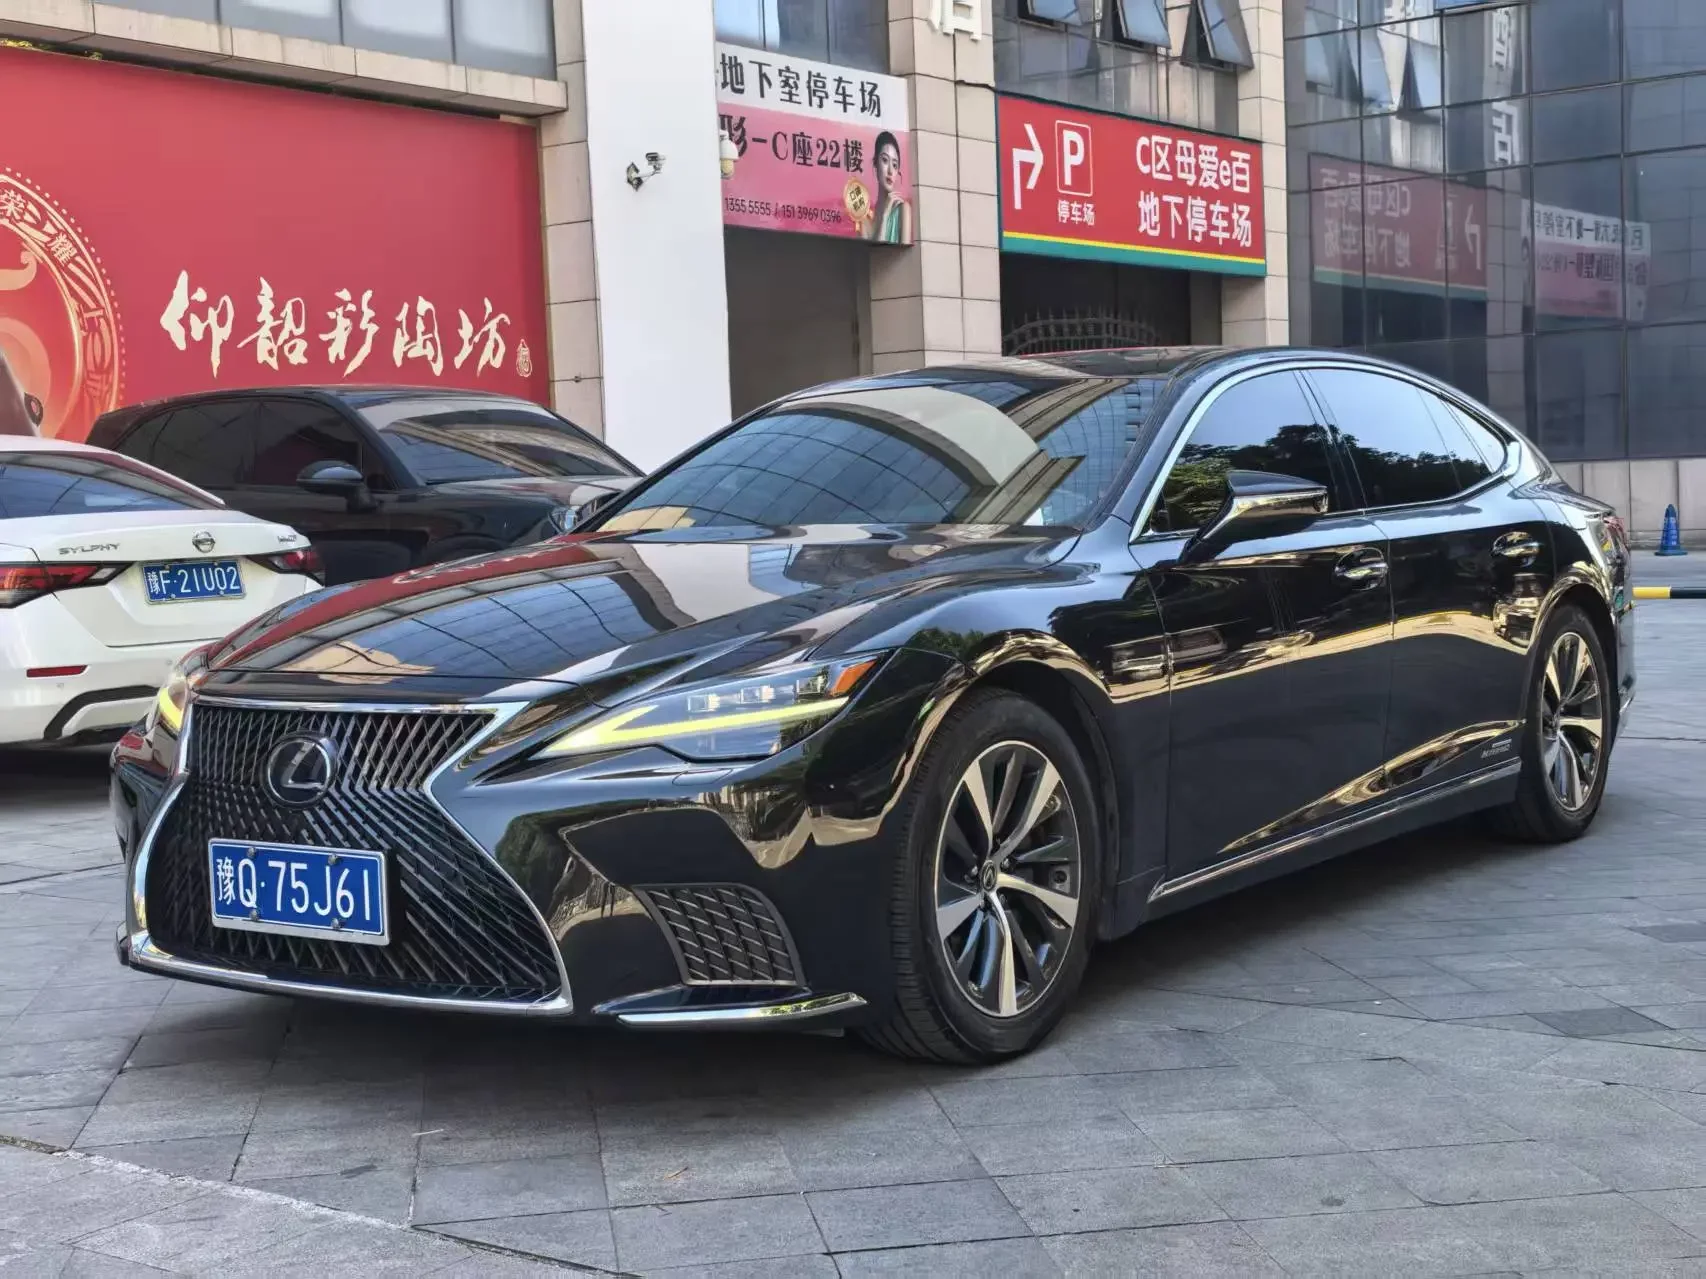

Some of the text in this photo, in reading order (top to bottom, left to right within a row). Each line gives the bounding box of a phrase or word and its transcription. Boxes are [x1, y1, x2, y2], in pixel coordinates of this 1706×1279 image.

[719, 53, 881, 118] 地下室停车场
[1063, 130, 1085, 186] P
[1136, 135, 1250, 193] C区母爱e百
[749, 199, 771, 216] 5555
[1057, 199, 1095, 226] 停车场
[1138, 190, 1252, 247] 地下停车场
[160, 270, 510, 378] 仰韶彩陶坊
[59, 543, 120, 555] SYLPHY
[216, 856, 370, 921] 豫Q·75J61
